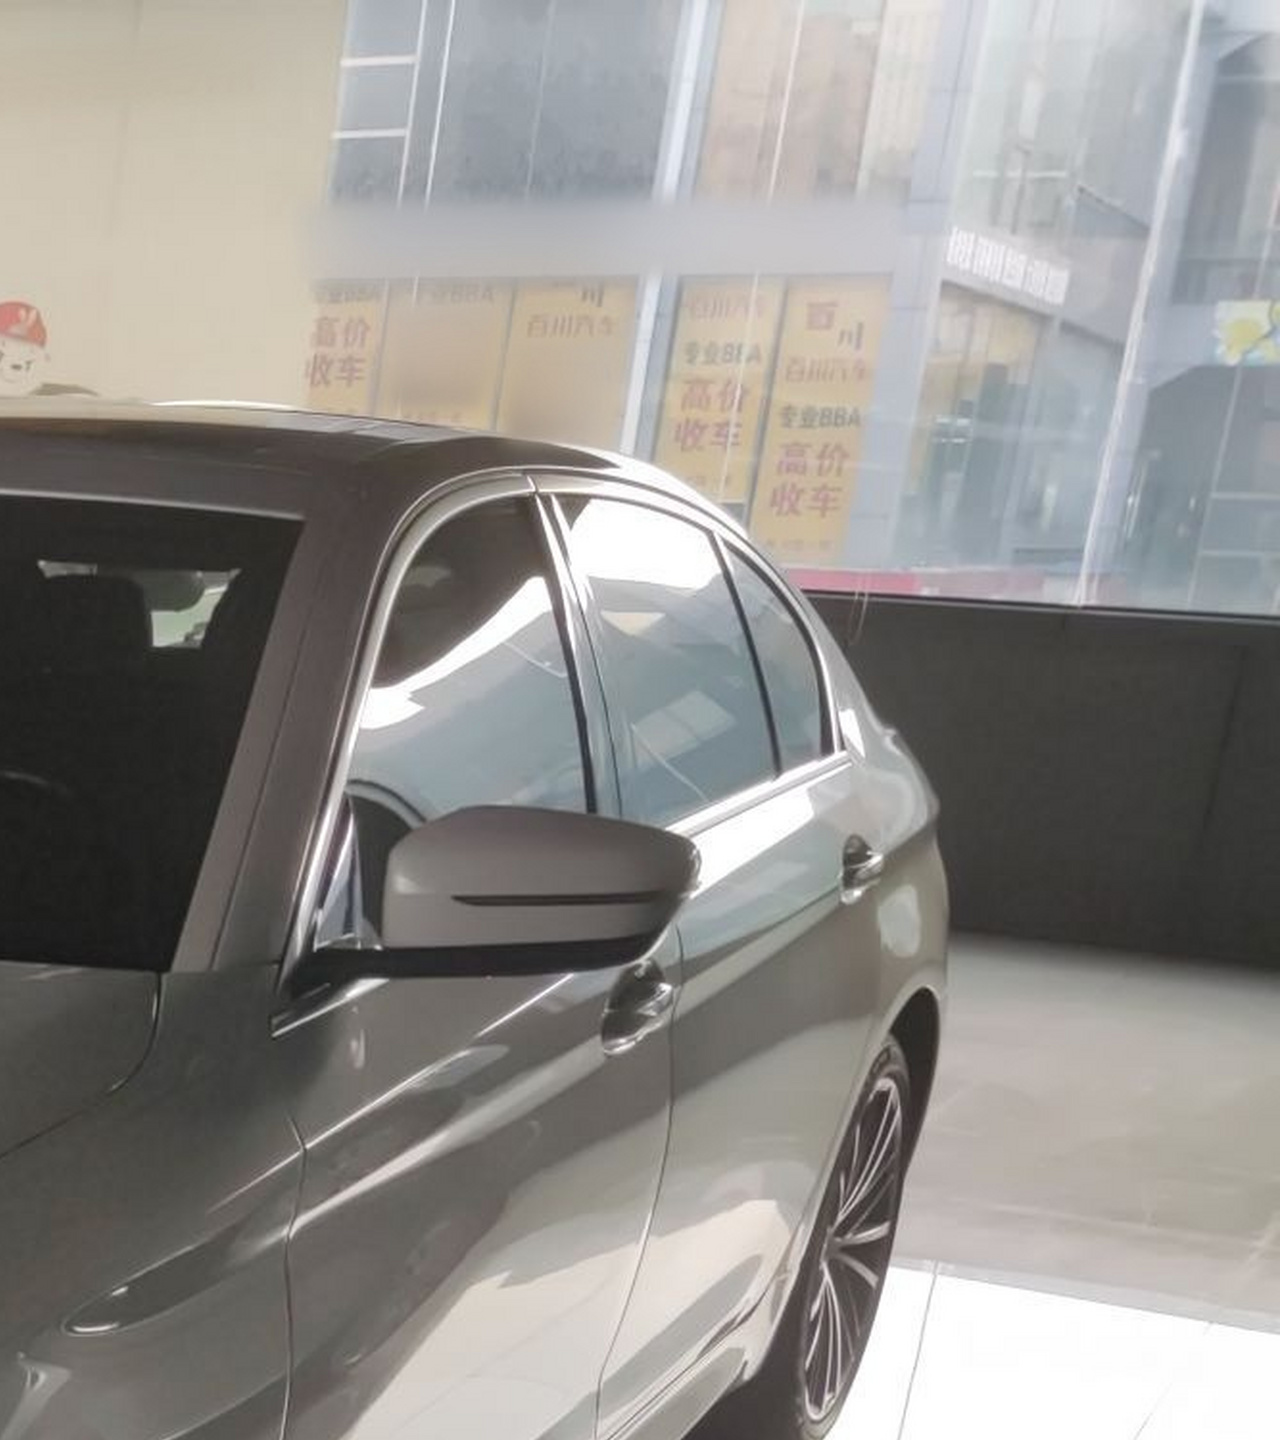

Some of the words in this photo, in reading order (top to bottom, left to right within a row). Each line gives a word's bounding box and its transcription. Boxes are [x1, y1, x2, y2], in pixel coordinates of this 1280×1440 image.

[312, 316, 372, 348] 高价
[303, 353, 366, 387] 收车
[680, 379, 750, 413] 高价
[779, 404, 861, 429] 专业BBA
[675, 417, 743, 452] 收车
[776, 442, 850, 476] 高价
[770, 482, 843, 518] 收车
